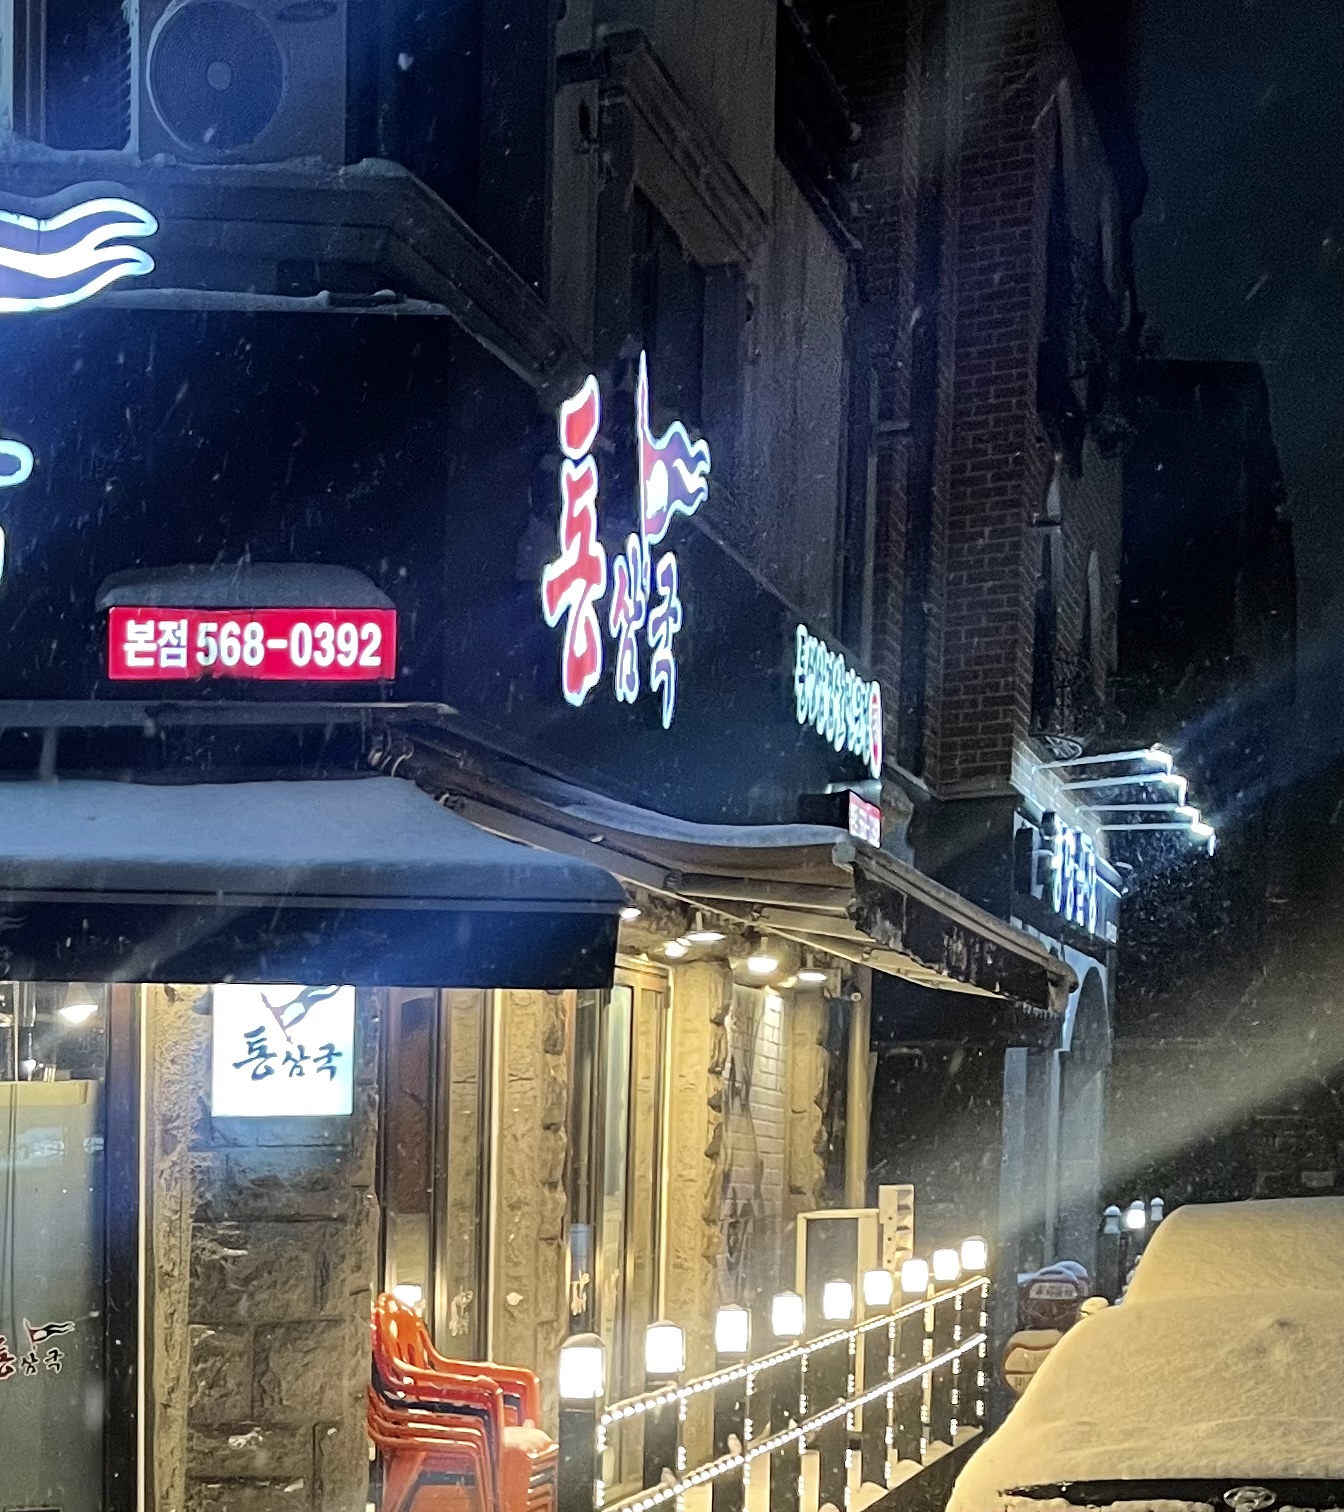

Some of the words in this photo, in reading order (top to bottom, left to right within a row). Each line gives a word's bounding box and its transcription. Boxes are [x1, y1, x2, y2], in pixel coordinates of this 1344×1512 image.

[541, 374, 683, 730] 통삼국
[124, 619, 188, 668] 본점
[196, 621, 381, 667] 568-0392
[232, 1025, 343, 1081] 통삼국
